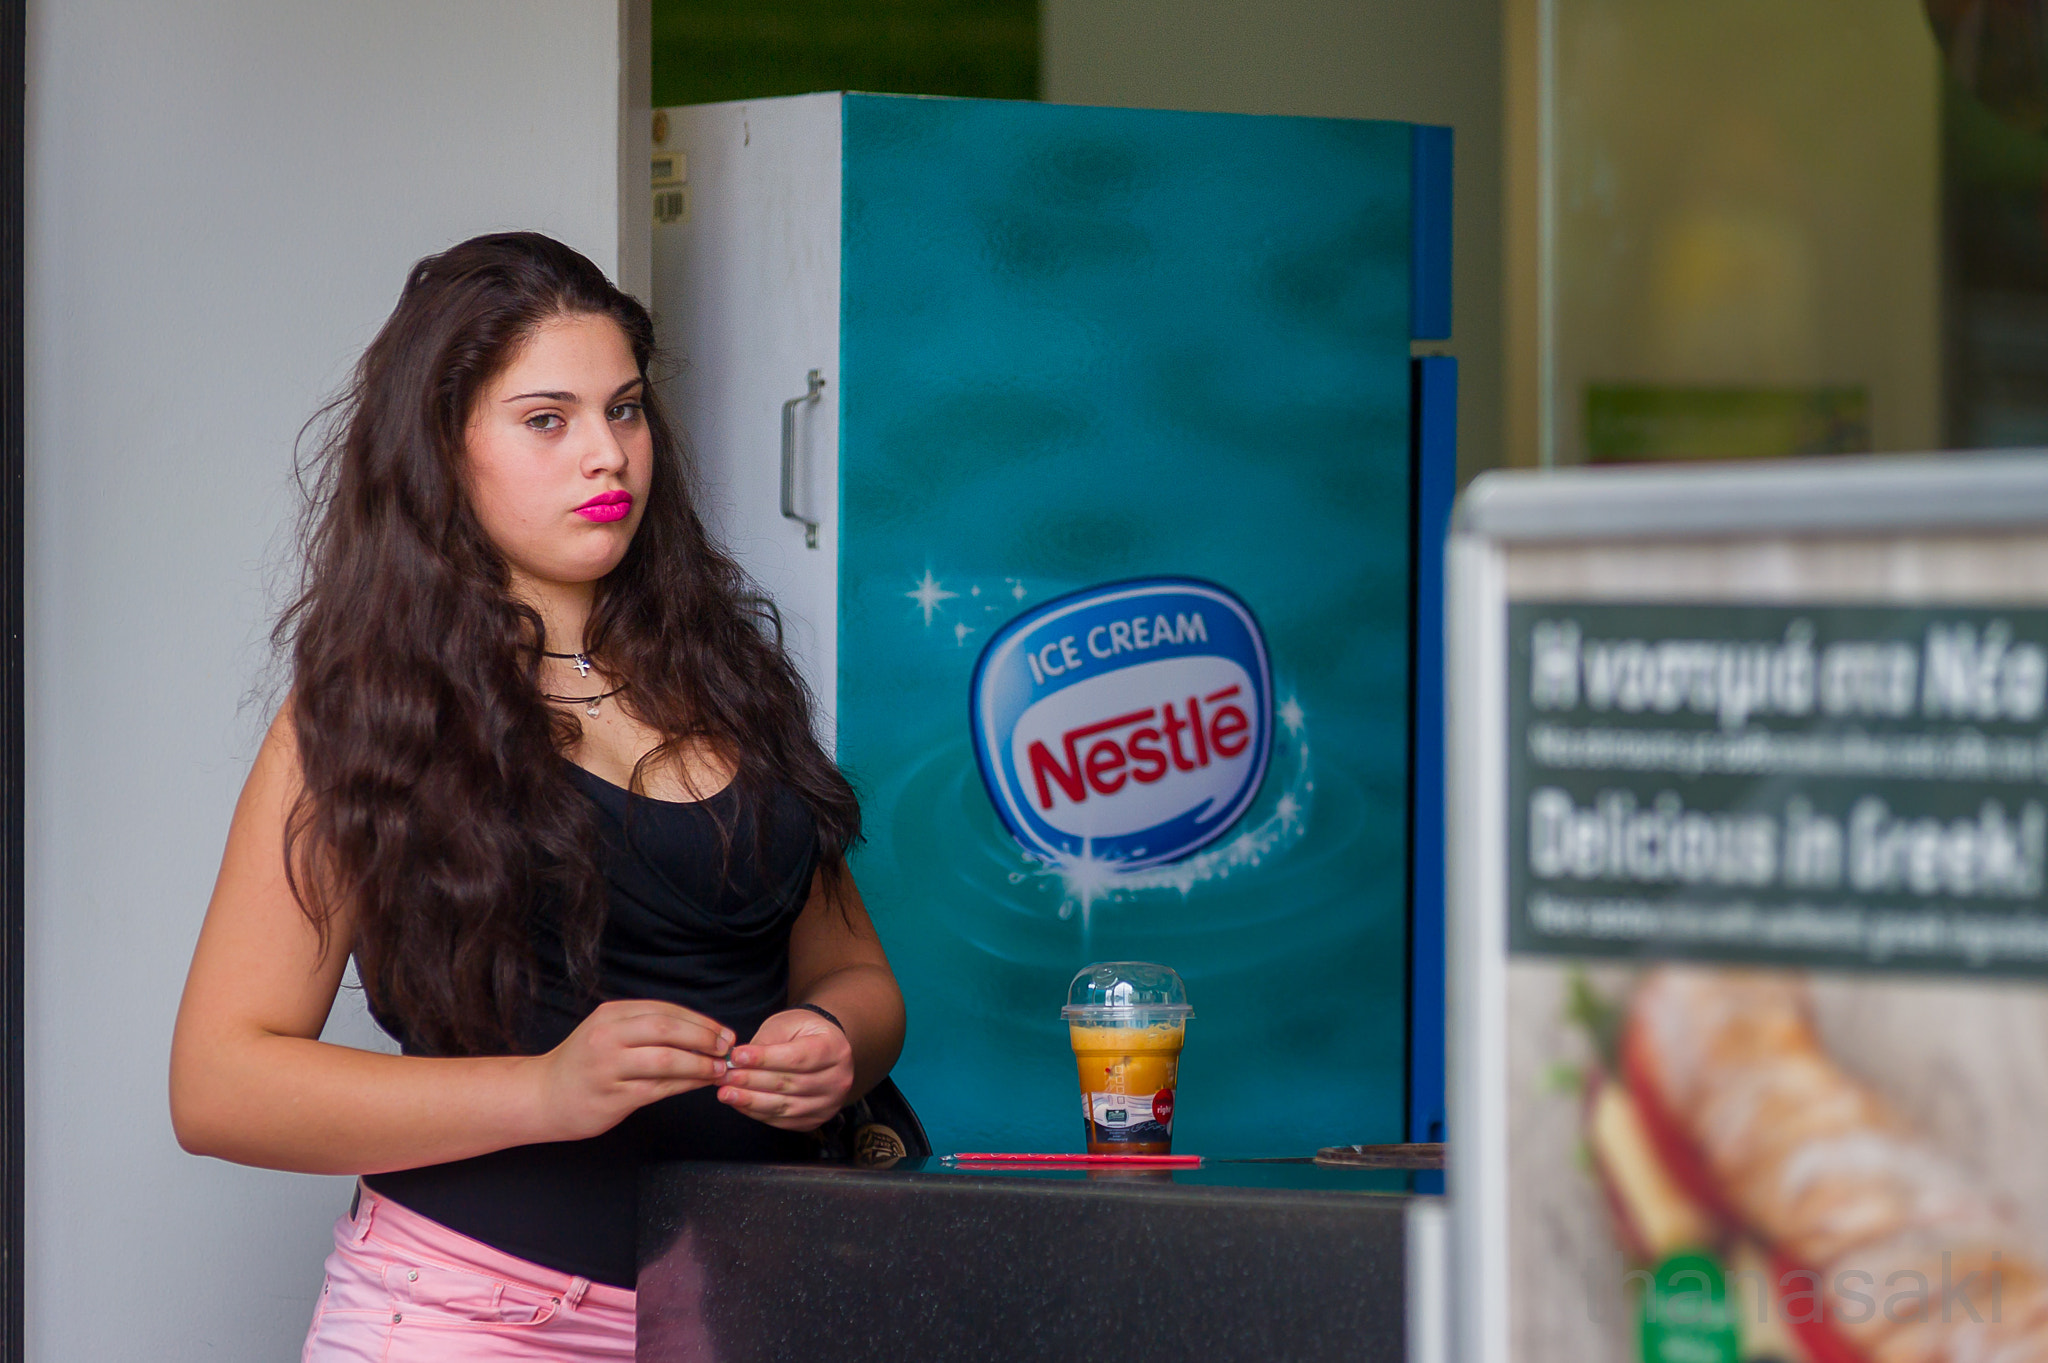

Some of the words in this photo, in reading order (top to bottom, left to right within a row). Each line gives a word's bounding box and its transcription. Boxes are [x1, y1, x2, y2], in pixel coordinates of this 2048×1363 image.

[1026, 635, 1083, 685] ICE
[1086, 612, 1208, 659] CREAM
[1529, 788, 1777, 888] Delicious
[1785, 796, 1842, 888] in
[1849, 795, 2045, 896] Greek!
